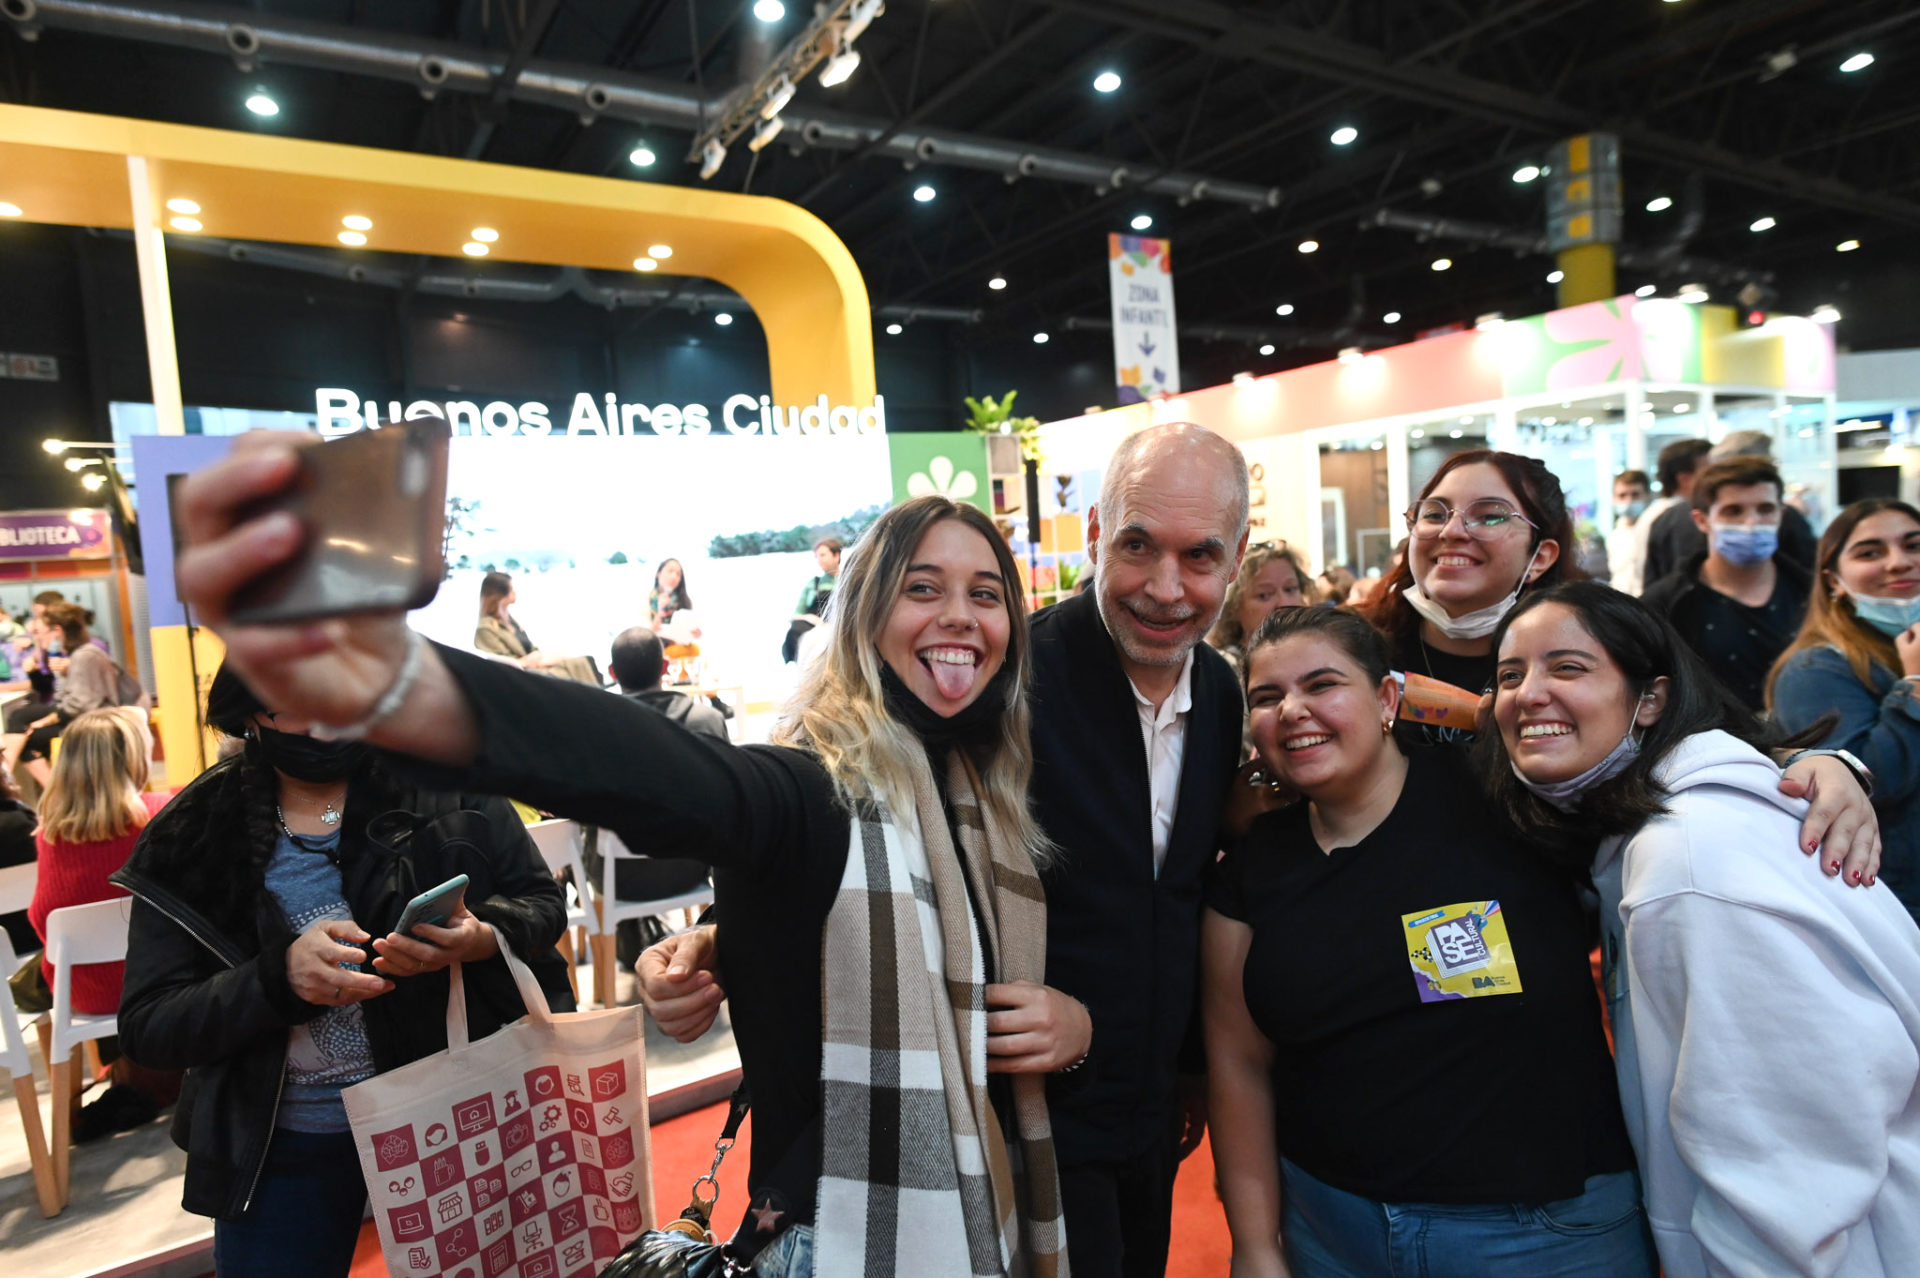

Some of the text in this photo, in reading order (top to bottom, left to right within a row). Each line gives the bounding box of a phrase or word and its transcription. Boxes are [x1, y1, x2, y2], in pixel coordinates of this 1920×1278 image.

[1128, 284, 1160, 302] ZONA
[1119, 305, 1168, 328] INFANTIL
[566, 392, 712, 436] Aires
[722, 393, 886, 436] Ciudad
[1465, 917, 1486, 956] CULTURAL
[1472, 976, 1496, 989] BA
